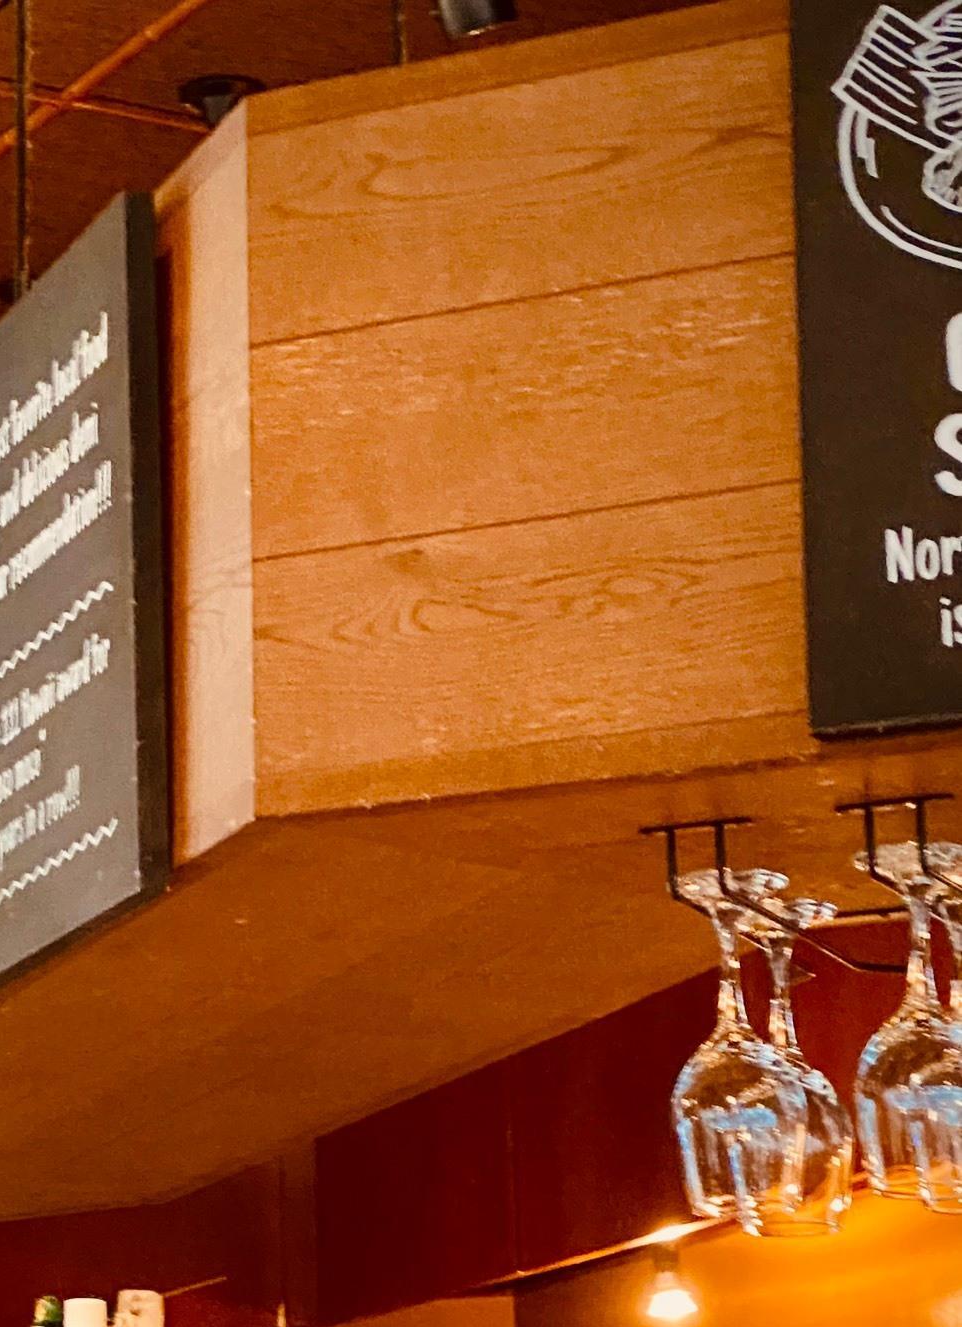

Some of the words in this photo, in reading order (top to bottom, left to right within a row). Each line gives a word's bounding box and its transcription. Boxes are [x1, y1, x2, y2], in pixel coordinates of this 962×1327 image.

[8, 380, 54, 446] favorite
[51, 341, 79, 407] local
[79, 311, 109, 380] food
[17, 439, 71, 508] delicious
[88, 633, 111, 676] for
[24, 803, 37, 839] in
[37, 800, 46, 832] a
